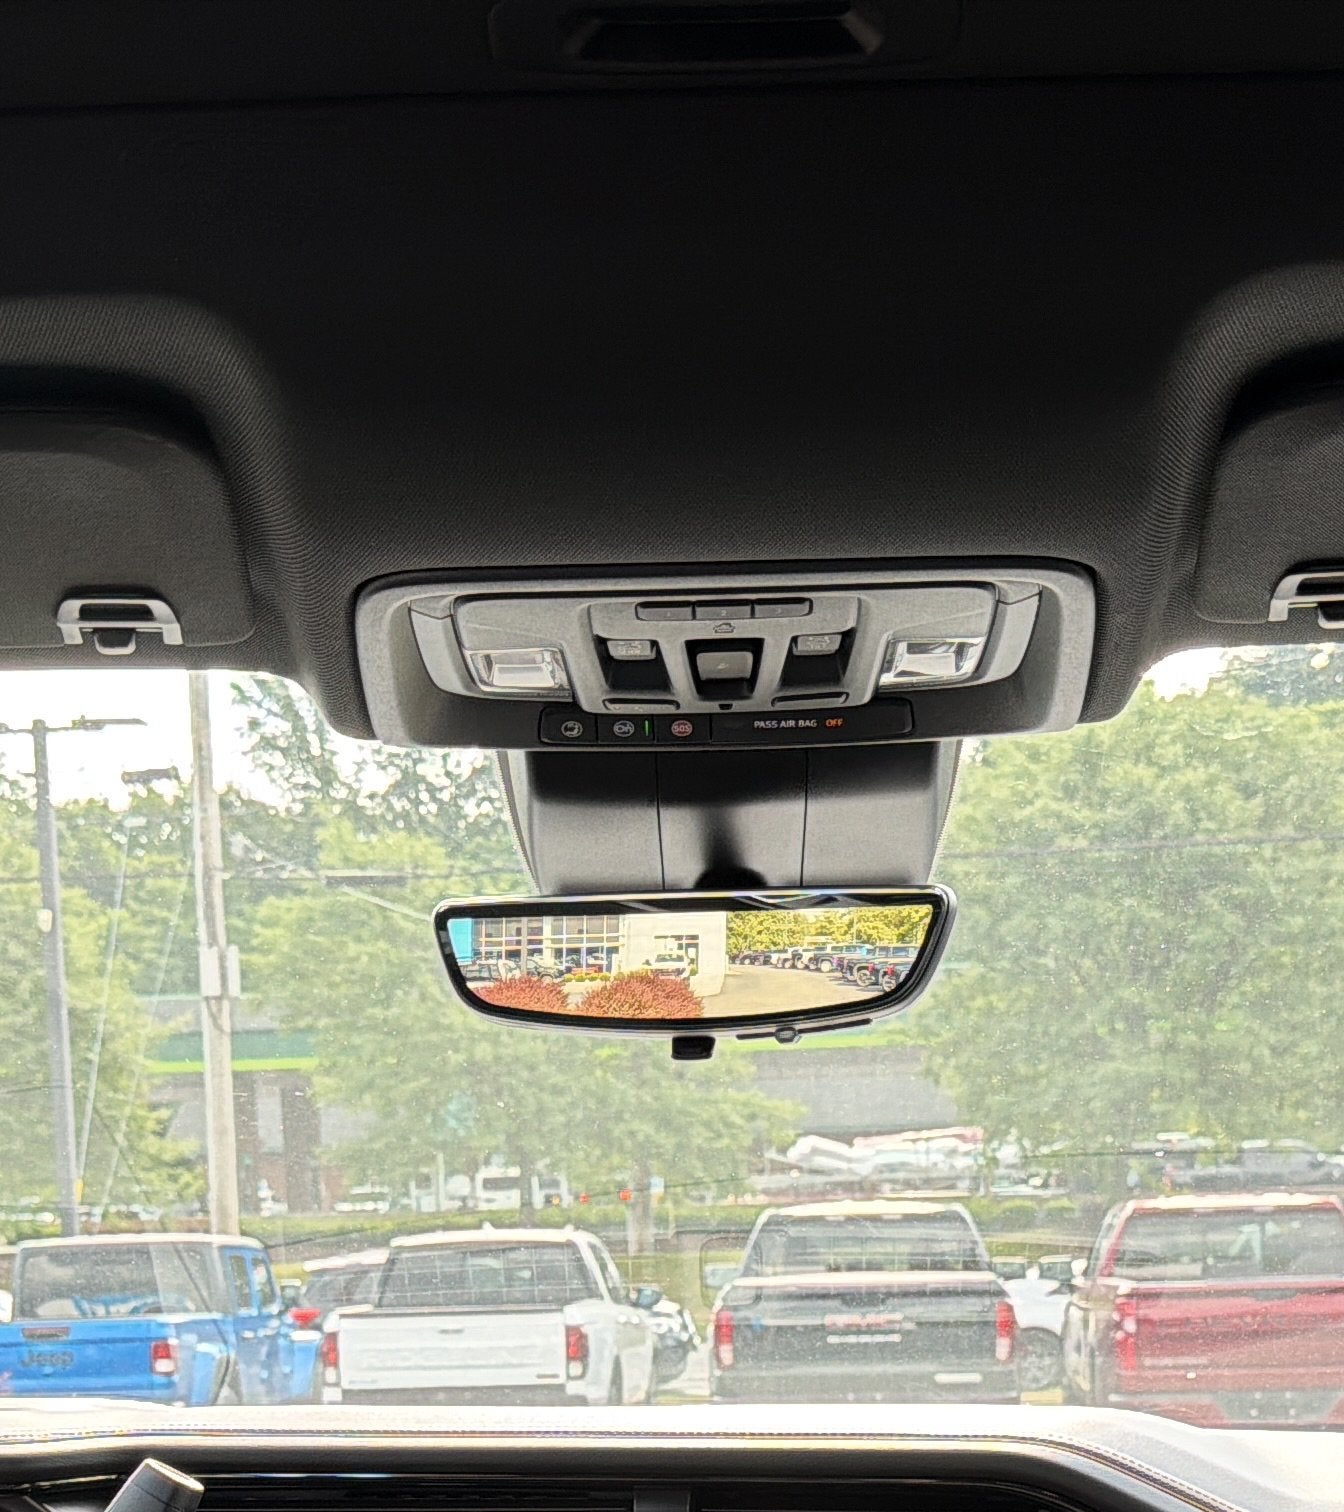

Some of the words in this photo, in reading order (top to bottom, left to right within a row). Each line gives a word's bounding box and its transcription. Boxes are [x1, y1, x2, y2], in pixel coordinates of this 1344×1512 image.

[753, 720, 778, 729] PASS
[779, 720, 796, 729] AIR
[798, 719, 818, 728] BAG
[825, 718, 843, 727] OFF
